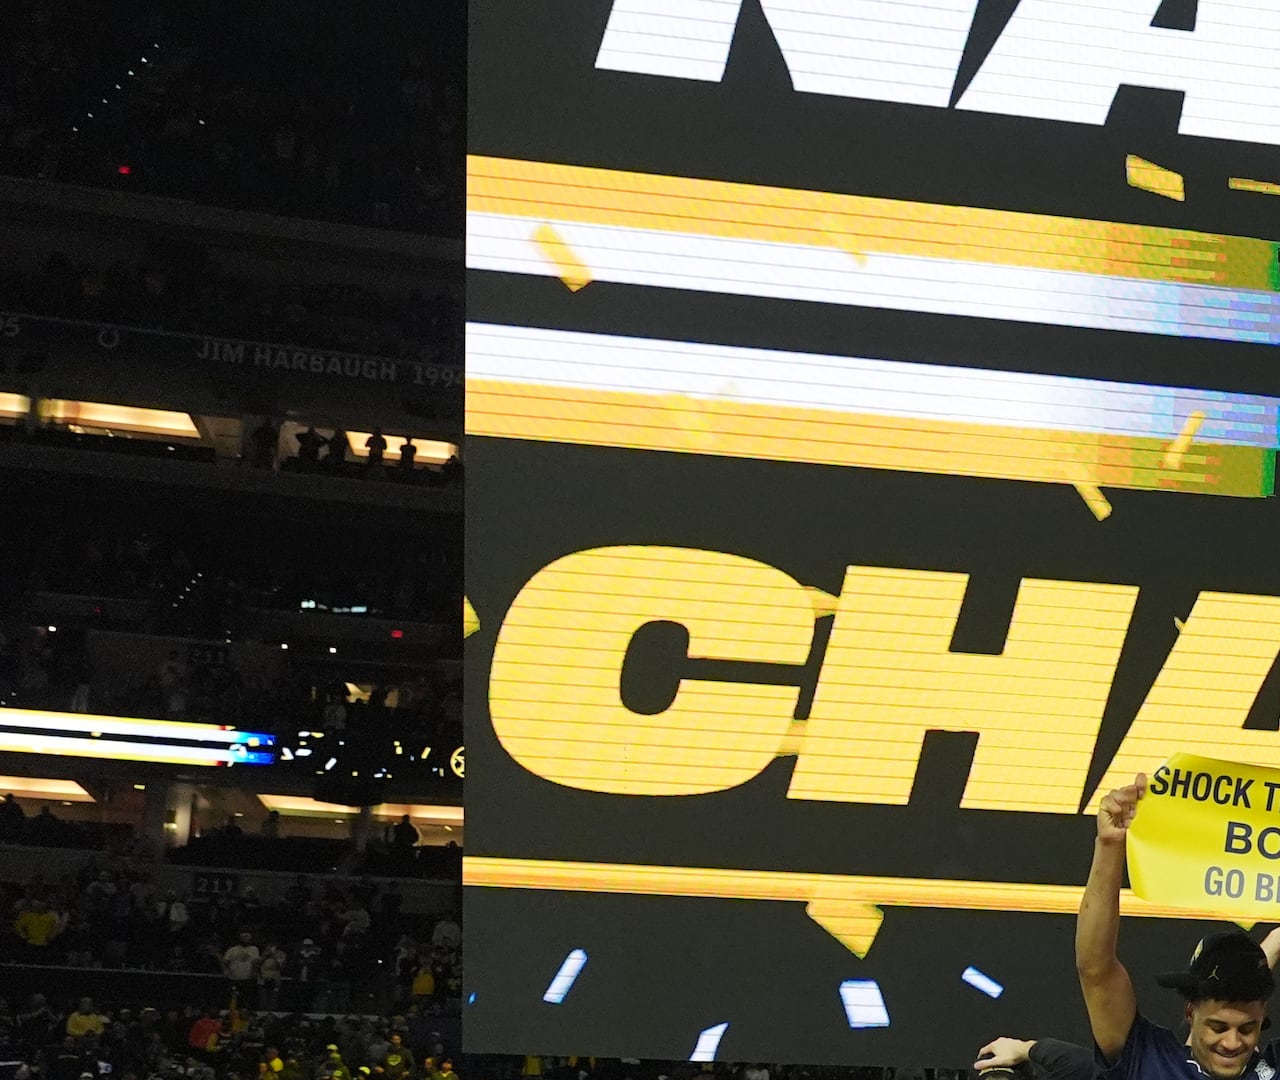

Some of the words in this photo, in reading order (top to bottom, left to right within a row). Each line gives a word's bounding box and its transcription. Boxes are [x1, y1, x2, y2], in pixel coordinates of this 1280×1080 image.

[198, 341, 244, 366] JIM
[254, 348, 397, 382] HARBAUGH
[1149, 764, 1256, 810] SHOCK
[1203, 865, 1245, 900] GO
